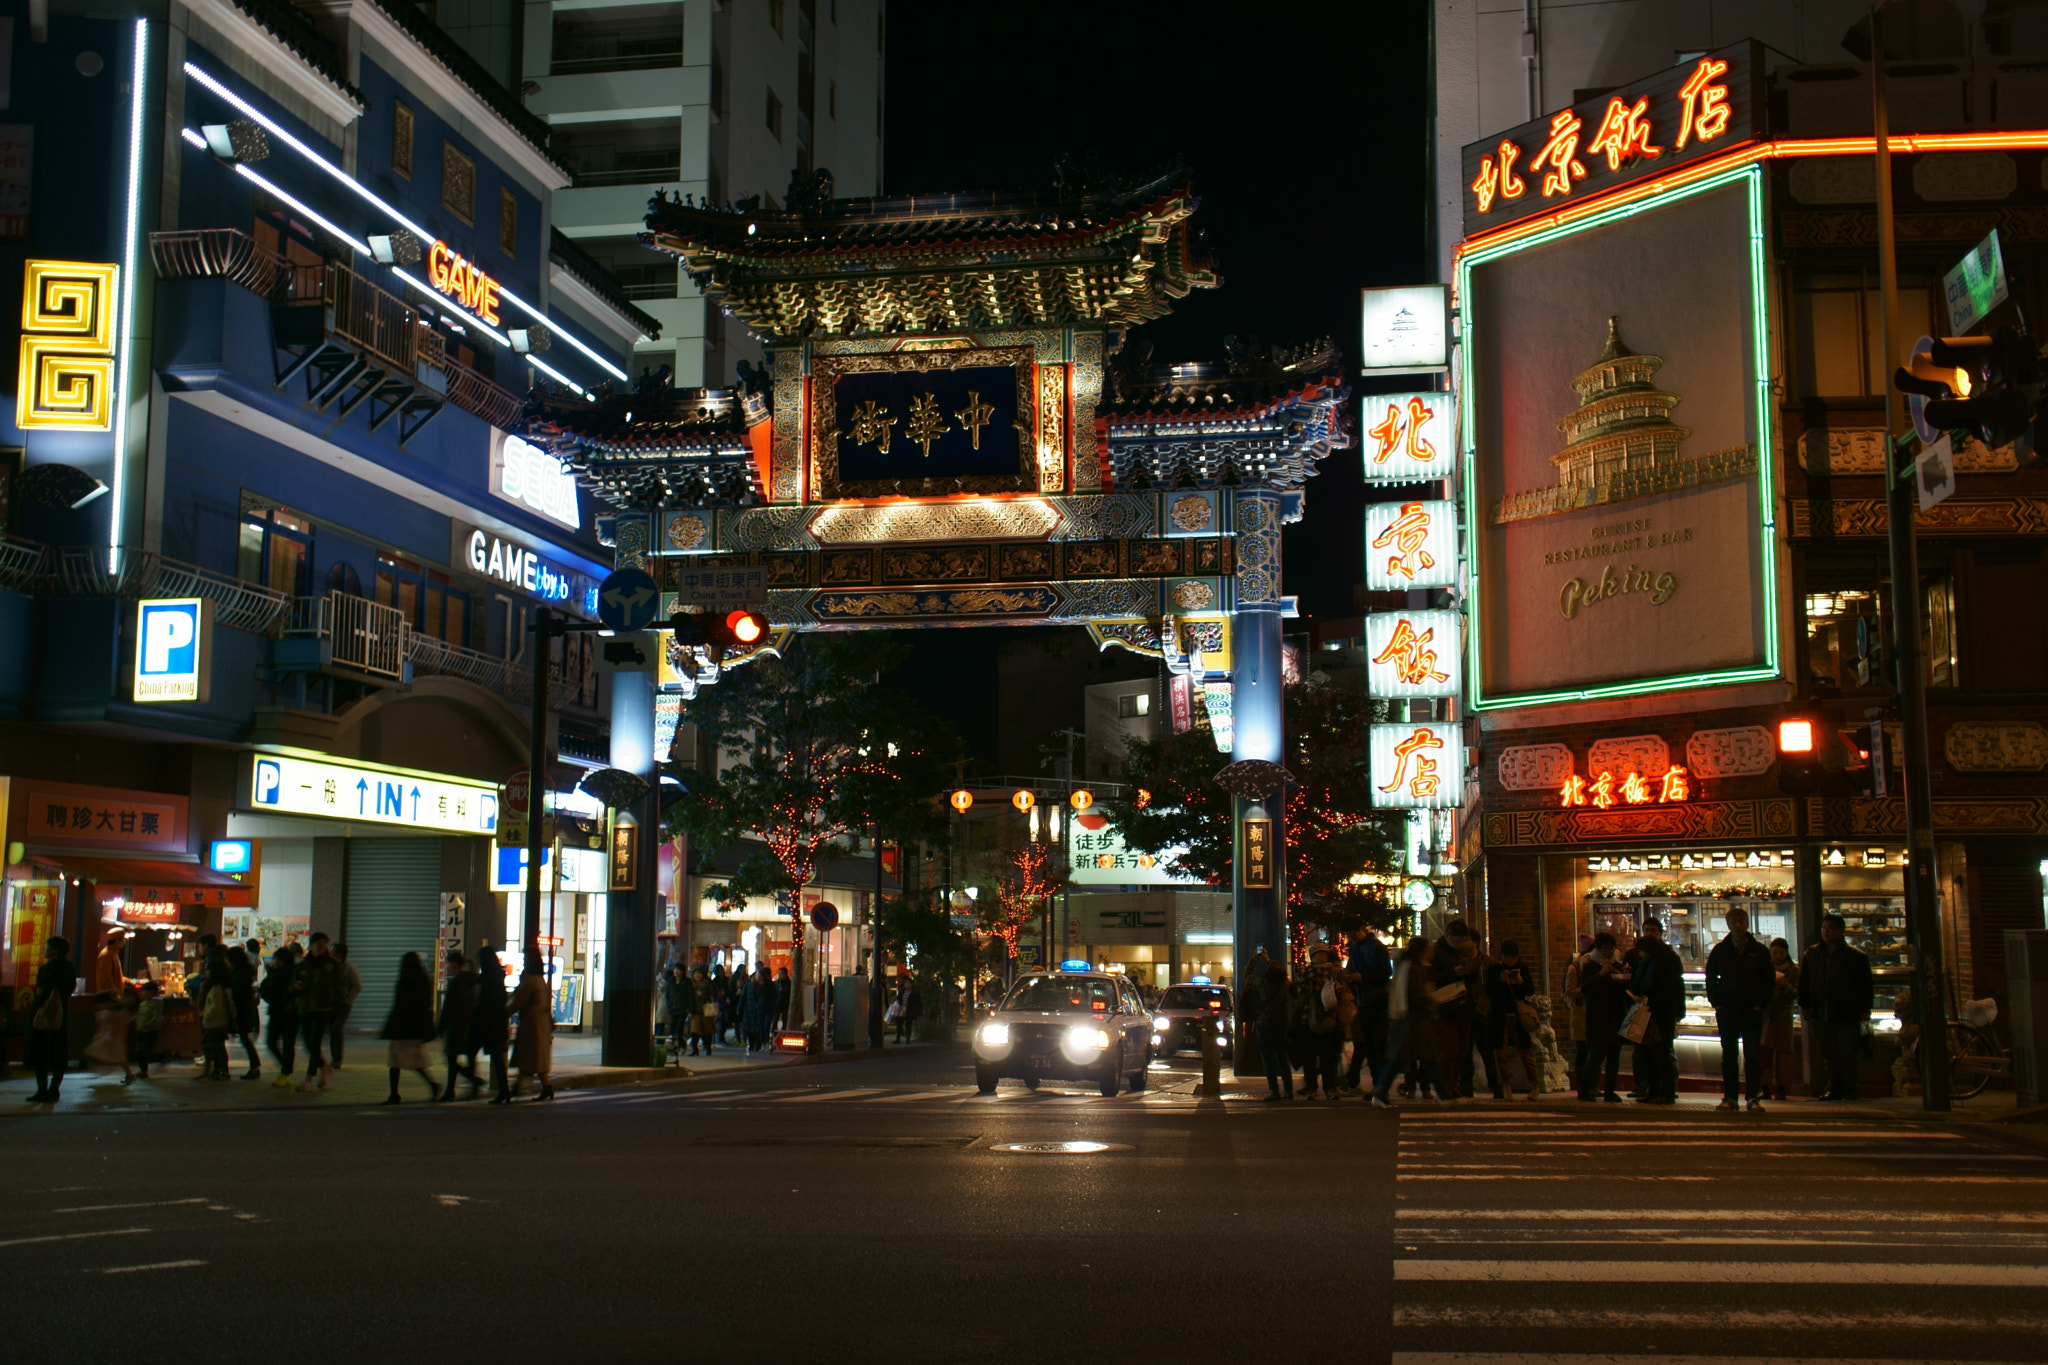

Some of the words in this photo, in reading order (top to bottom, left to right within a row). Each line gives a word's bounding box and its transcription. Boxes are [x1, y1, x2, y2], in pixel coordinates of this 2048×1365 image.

[1472, 57, 1732, 213] 北京飯店
[429, 239, 500, 327] GAME
[846, 390, 996, 458] 中華街
[503, 435, 580, 529] SEGA
[1543, 537, 1641, 566] RESTAURANT
[1645, 535, 1656, 549] &
[1660, 527, 1693, 545] BAR
[1590, 518, 1652, 540] CHINESE
[469, 530, 538, 592] GAME
[685, 571, 761, 590] 中華街東門
[690, 591, 716, 601] China
[720, 590, 743, 600] Town
[1369, 396, 1451, 798] 北京飯店
[1559, 564, 1679, 620] Peking
[138, 680, 162, 696] China
[163, 680, 196, 697] Parking
[300, 777, 337, 804] 一般
[376, 780, 403, 818] IN
[1560, 764, 1690, 810] 北京飯店
[46, 804, 160, 835] 聘珍大甘栗
[616, 831, 630, 882] 朝陽門
[1075, 853, 1179, 870] 新浜ラメン
[1249, 825, 1265, 880] 朝陽門
